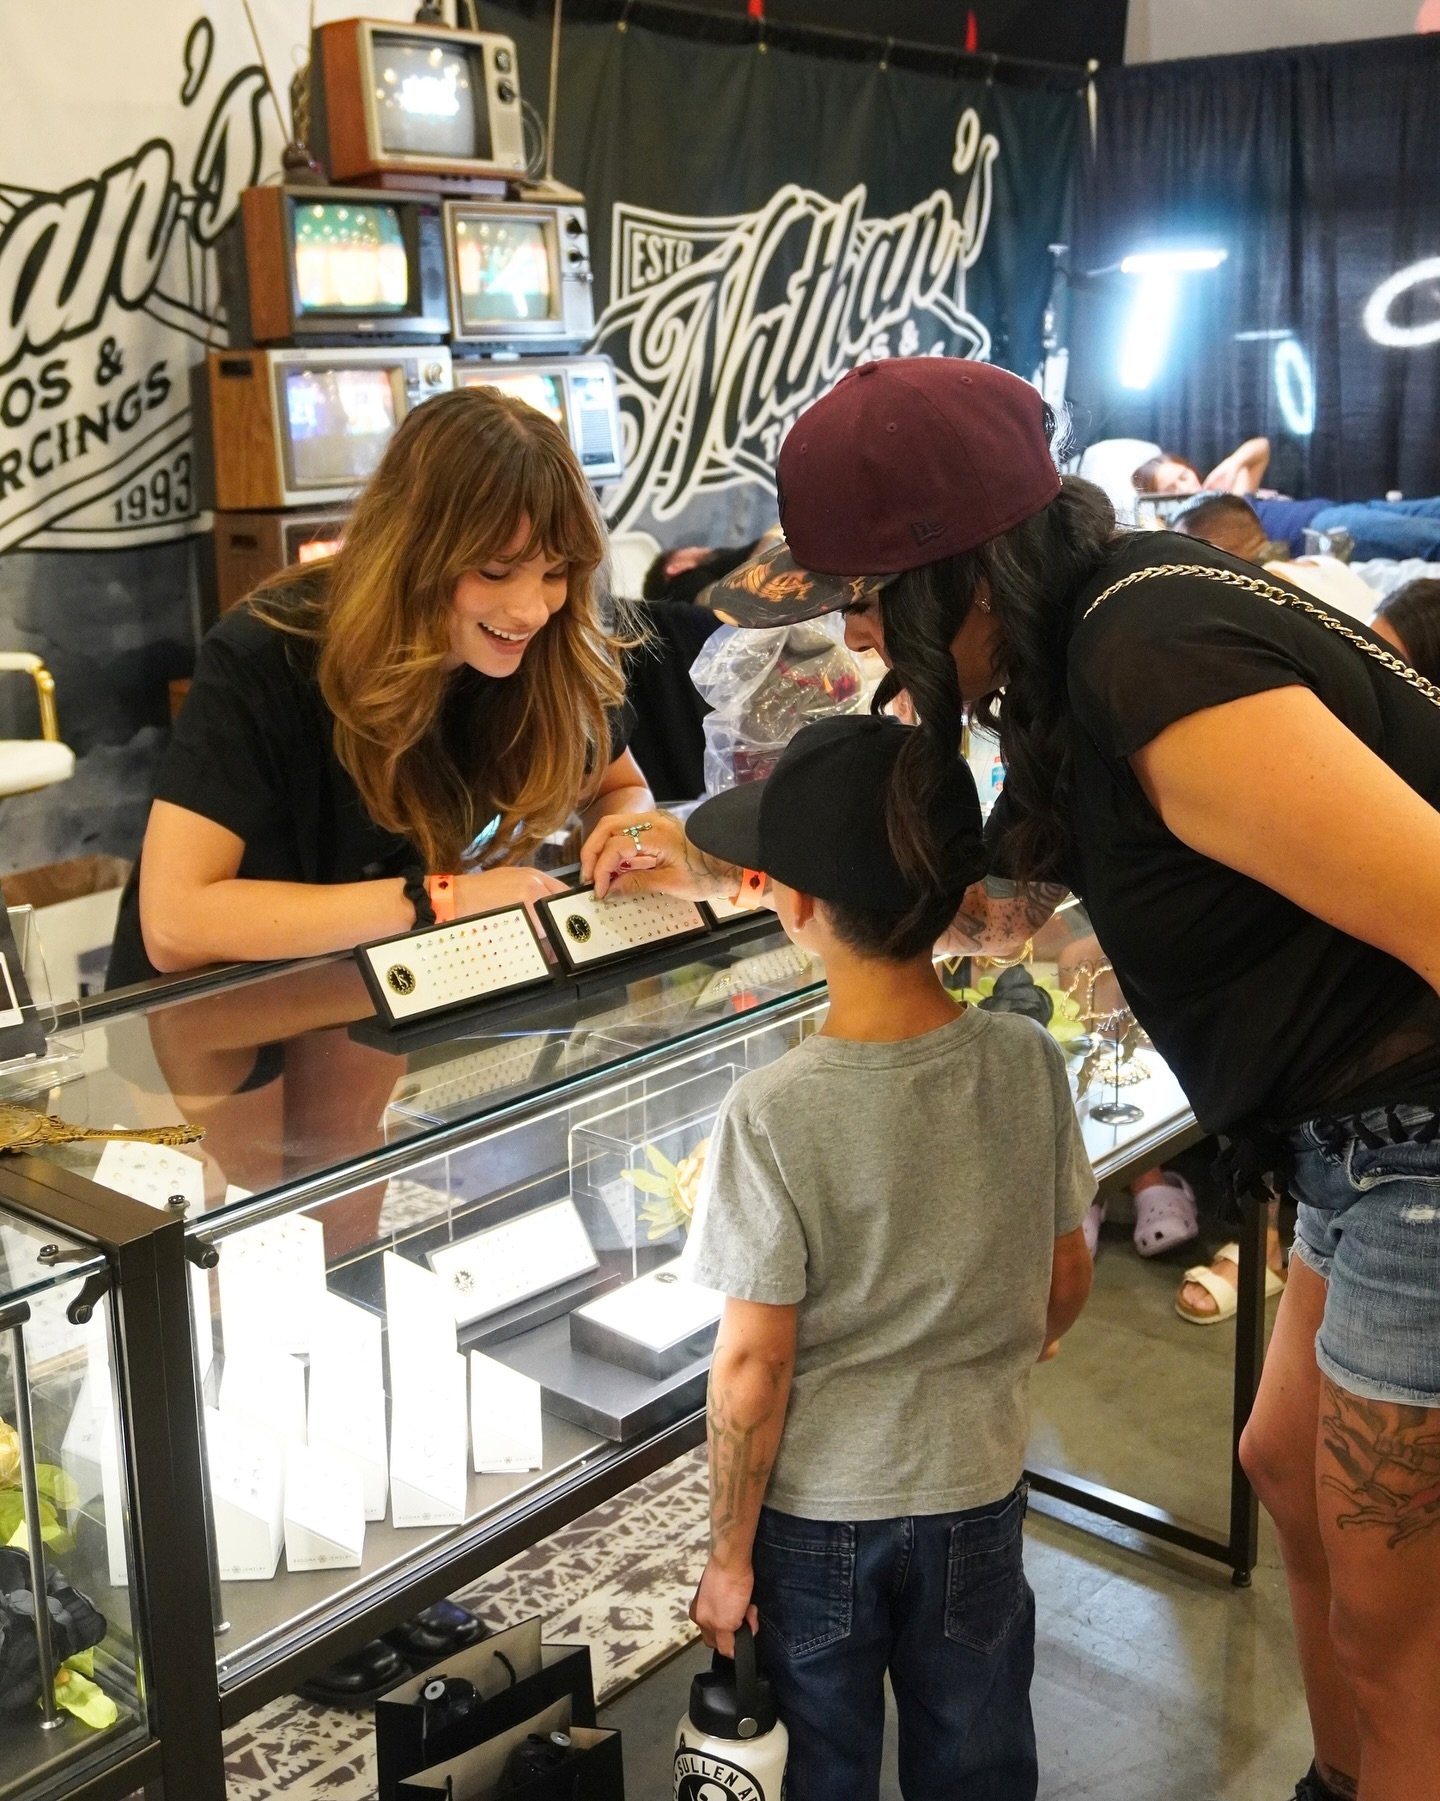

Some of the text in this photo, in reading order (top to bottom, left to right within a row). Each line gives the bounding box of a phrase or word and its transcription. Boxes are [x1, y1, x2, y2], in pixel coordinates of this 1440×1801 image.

[94, 335, 124, 387] &
[113, 450, 192, 522] 1993
[677, 1757, 739, 1788] SULLEN
